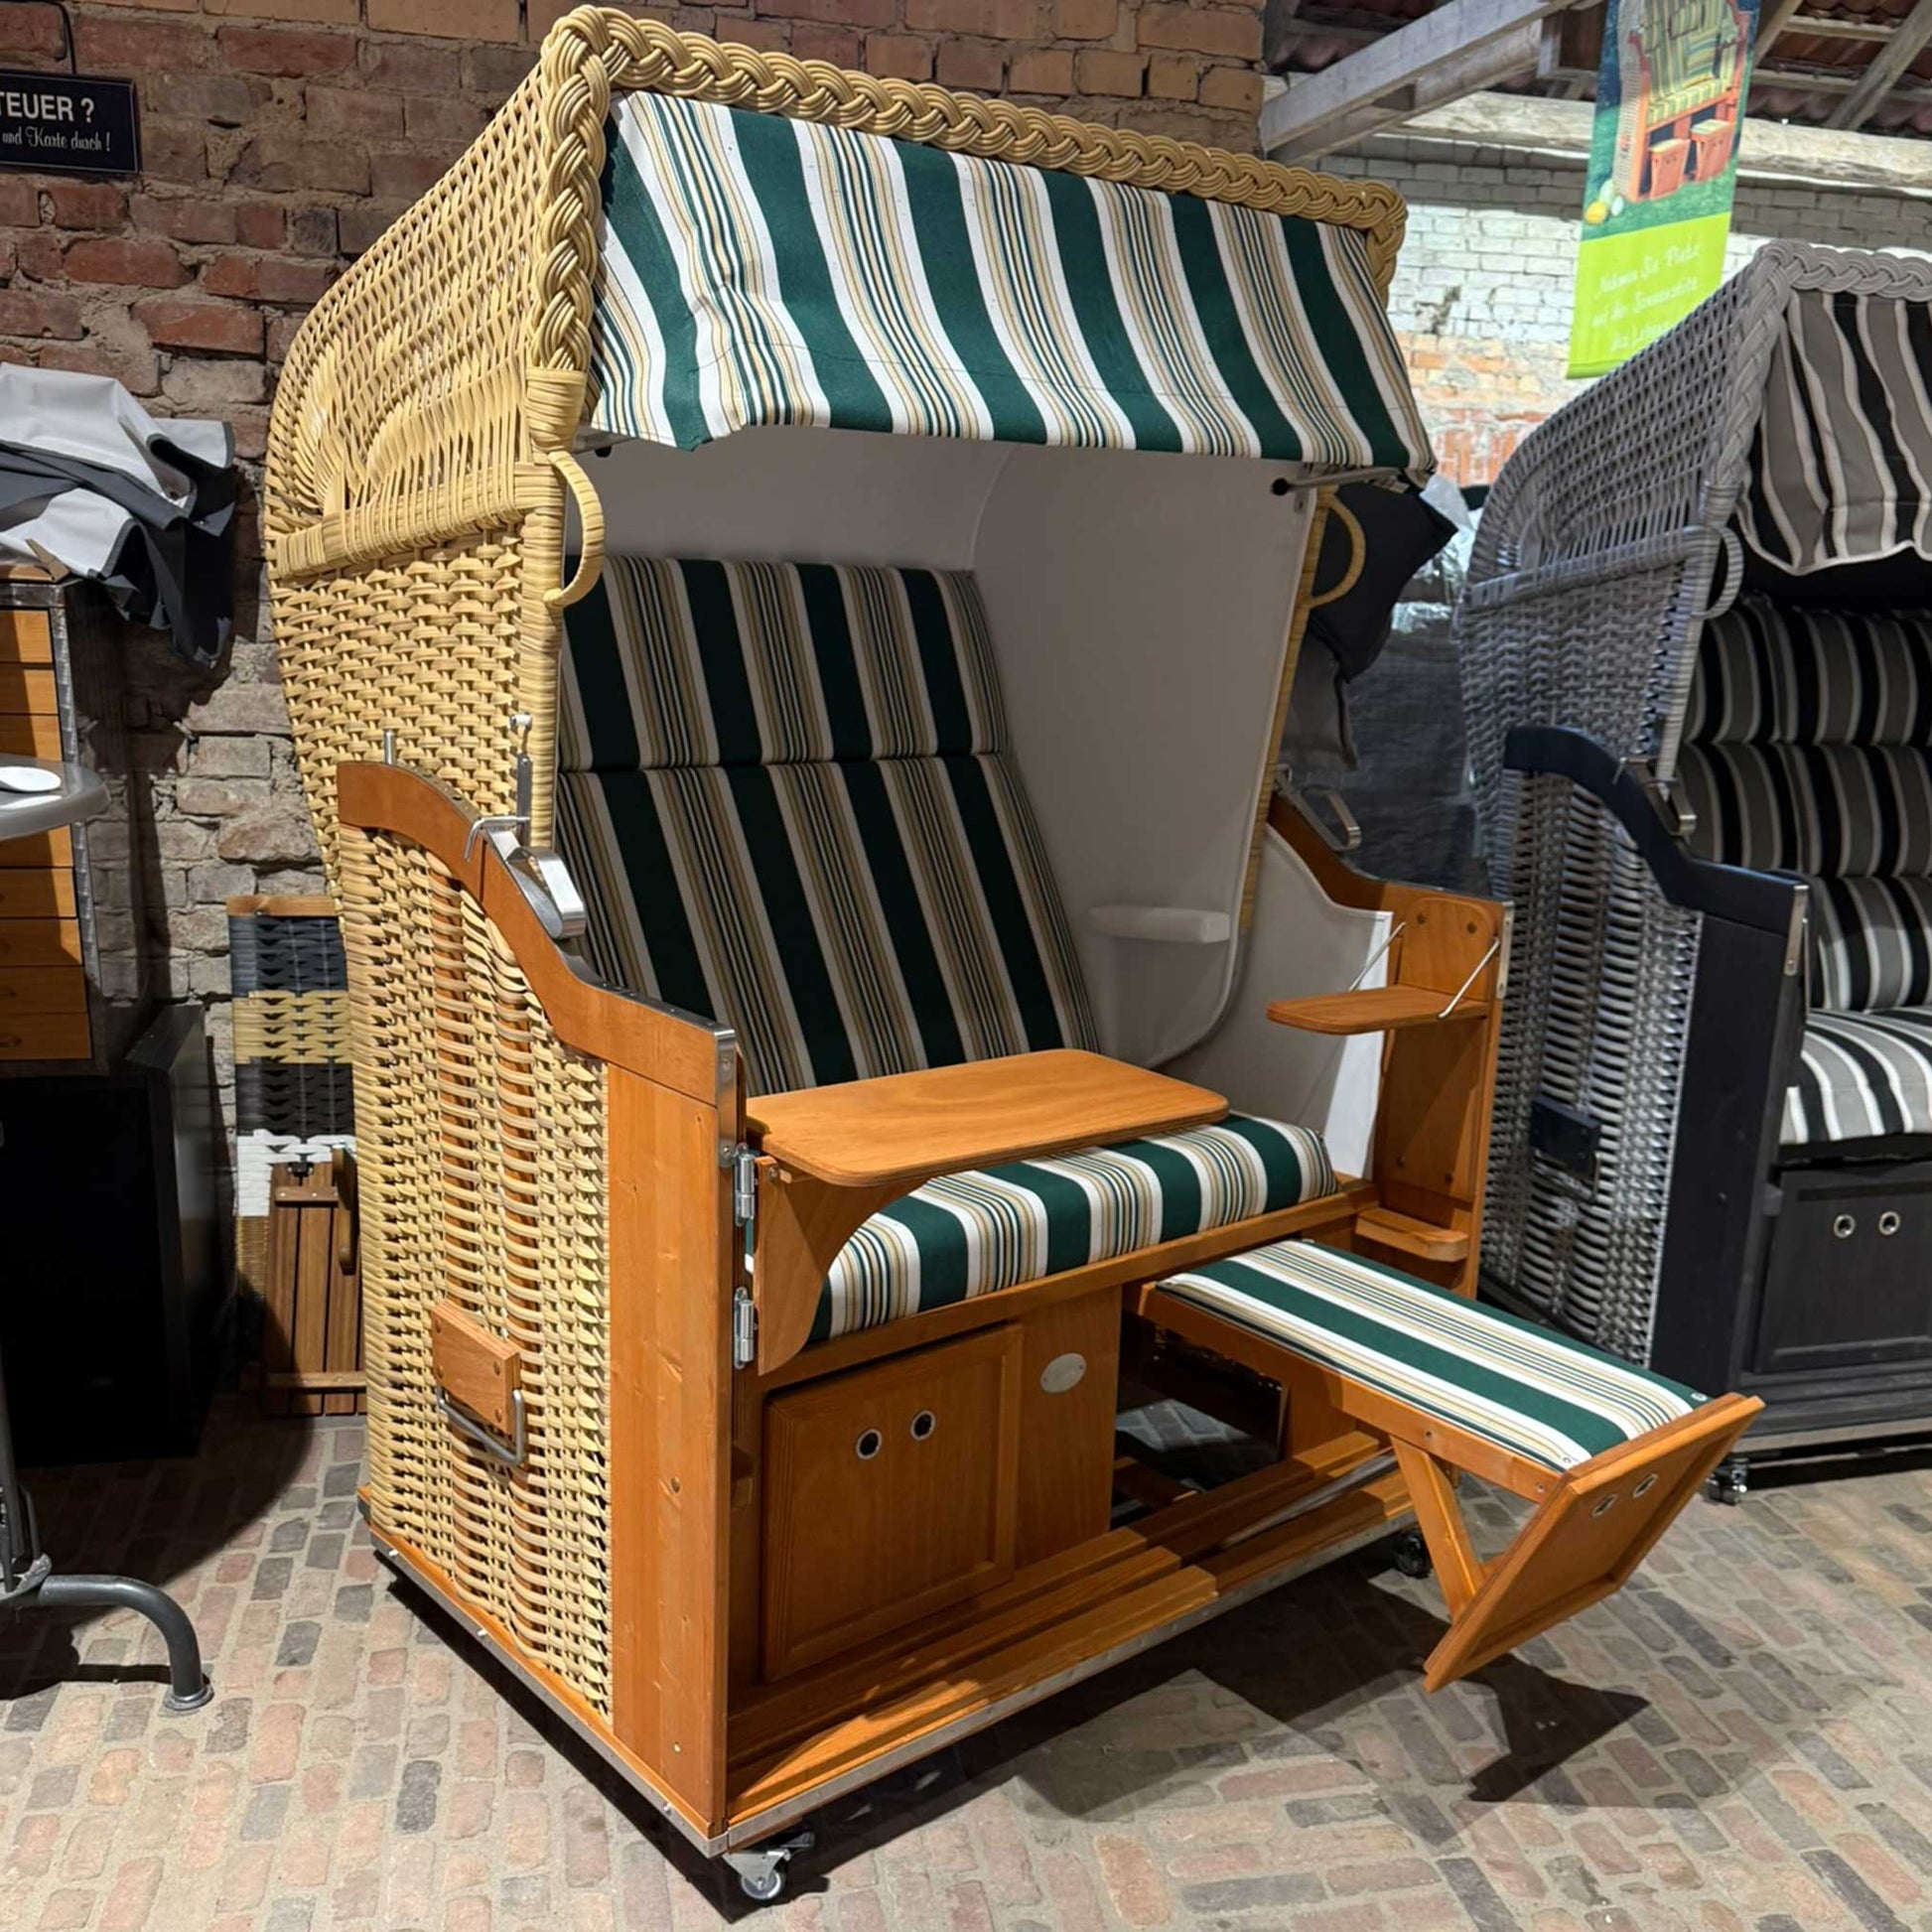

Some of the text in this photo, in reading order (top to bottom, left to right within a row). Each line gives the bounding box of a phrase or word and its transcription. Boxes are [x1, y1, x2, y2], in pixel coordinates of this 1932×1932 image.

[80, 97, 95, 123] ?
[2, 125, 111, 152] und Karte durch !
